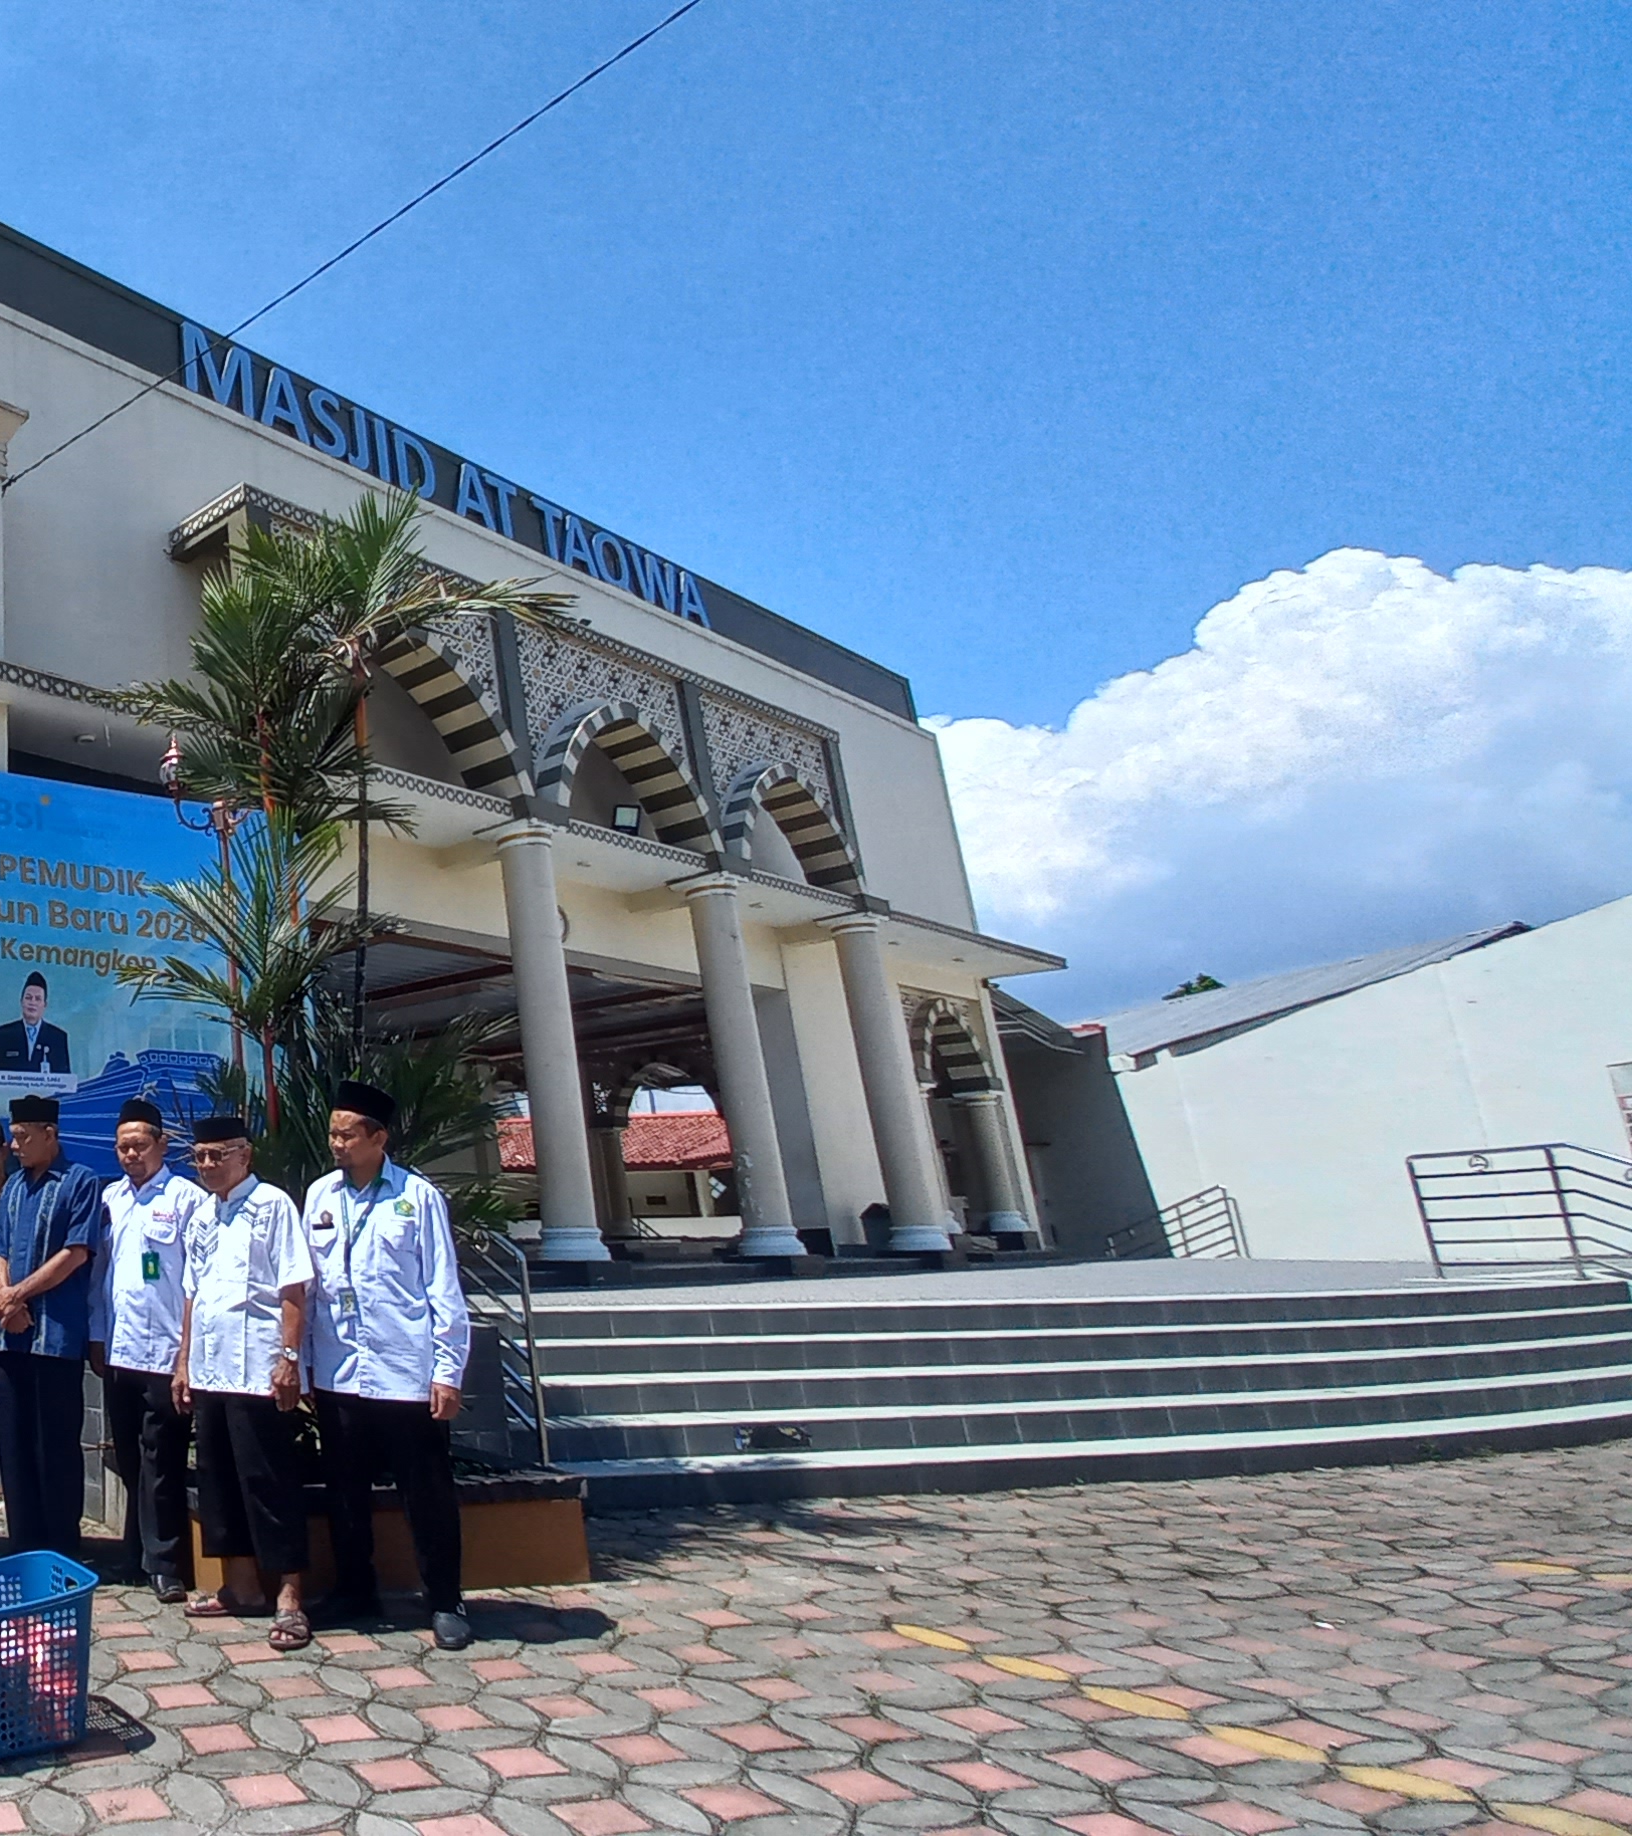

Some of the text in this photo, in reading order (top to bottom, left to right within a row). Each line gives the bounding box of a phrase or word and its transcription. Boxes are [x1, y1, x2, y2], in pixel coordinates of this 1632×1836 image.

[180, 320, 713, 630] MASJID AT TAQWA
[48, 898, 128, 936] Baru
[136, 908, 206, 943] 2026
